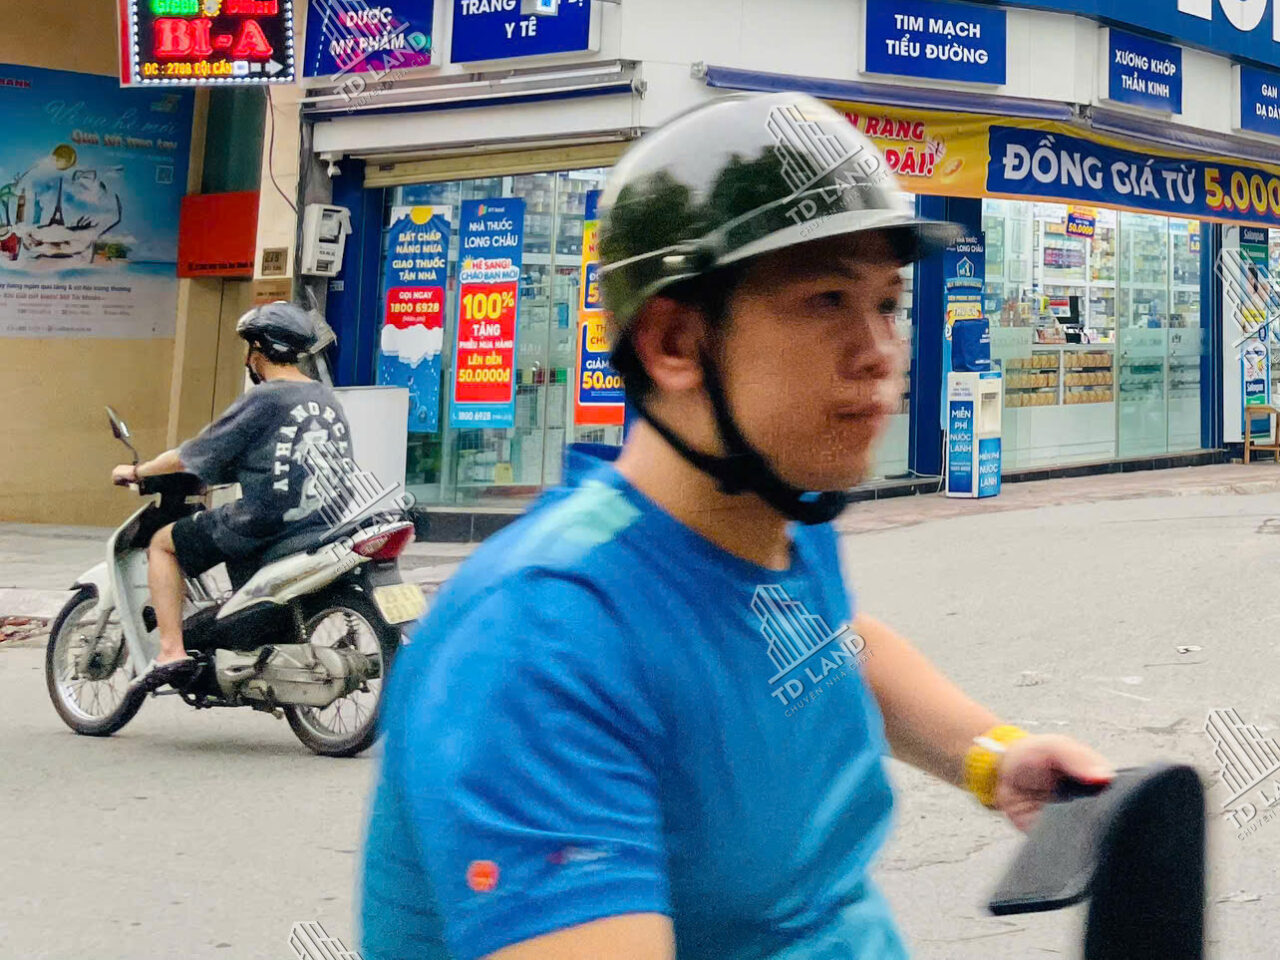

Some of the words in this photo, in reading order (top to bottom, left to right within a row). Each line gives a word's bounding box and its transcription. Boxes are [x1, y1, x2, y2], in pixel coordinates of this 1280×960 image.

[346, 7, 392, 27] DƯỢC
[504, 23, 514, 38] Y
[894, 14, 924, 32] TIM
[929, 18, 981, 39] MẠCH
[330, 34, 356, 56] MỸ
[358, 25, 404, 52] PHẨM
[886, 34, 920, 57] TIỂU
[925, 41, 989, 65] ĐƯỜNG
[1115, 49, 1149, 70] XƯƠNG
[1150, 57, 1177, 76] KHỚP
[1148, 82, 1170, 97] KINH
[1261, 84, 1278, 99] GAN
[1256, 103, 1267, 120] DẠ
[1003, 136, 1104, 190] ĐỒNG
[1110, 159, 1157, 199] GIÁ
[1161, 164, 1196, 205] TỪ
[469, 220, 485, 231] NHÀ
[487, 217, 512, 230] THUỐC
[464, 237, 490, 248] LONG
[492, 233, 518, 246] CHÂU
[393, 260, 413, 268] GIAO
[416, 256, 445, 267] THUỐC
[399, 270, 416, 282] TẬN
[419, 270, 437, 280] NHÀ
[399, 291, 411, 300] GỌI
[413, 291, 433, 299] NGAY
[391, 302, 413, 312] 1800
[415, 302, 439, 312] 6928
[463, 291, 515, 320] 100%
[473, 321, 501, 339] TẶNG
[468, 353, 484, 365] LÊN
[485, 350, 502, 365] ĐẾN
[952, 406, 971, 418] MIỄN
[955, 420, 967, 430] PHÍ
